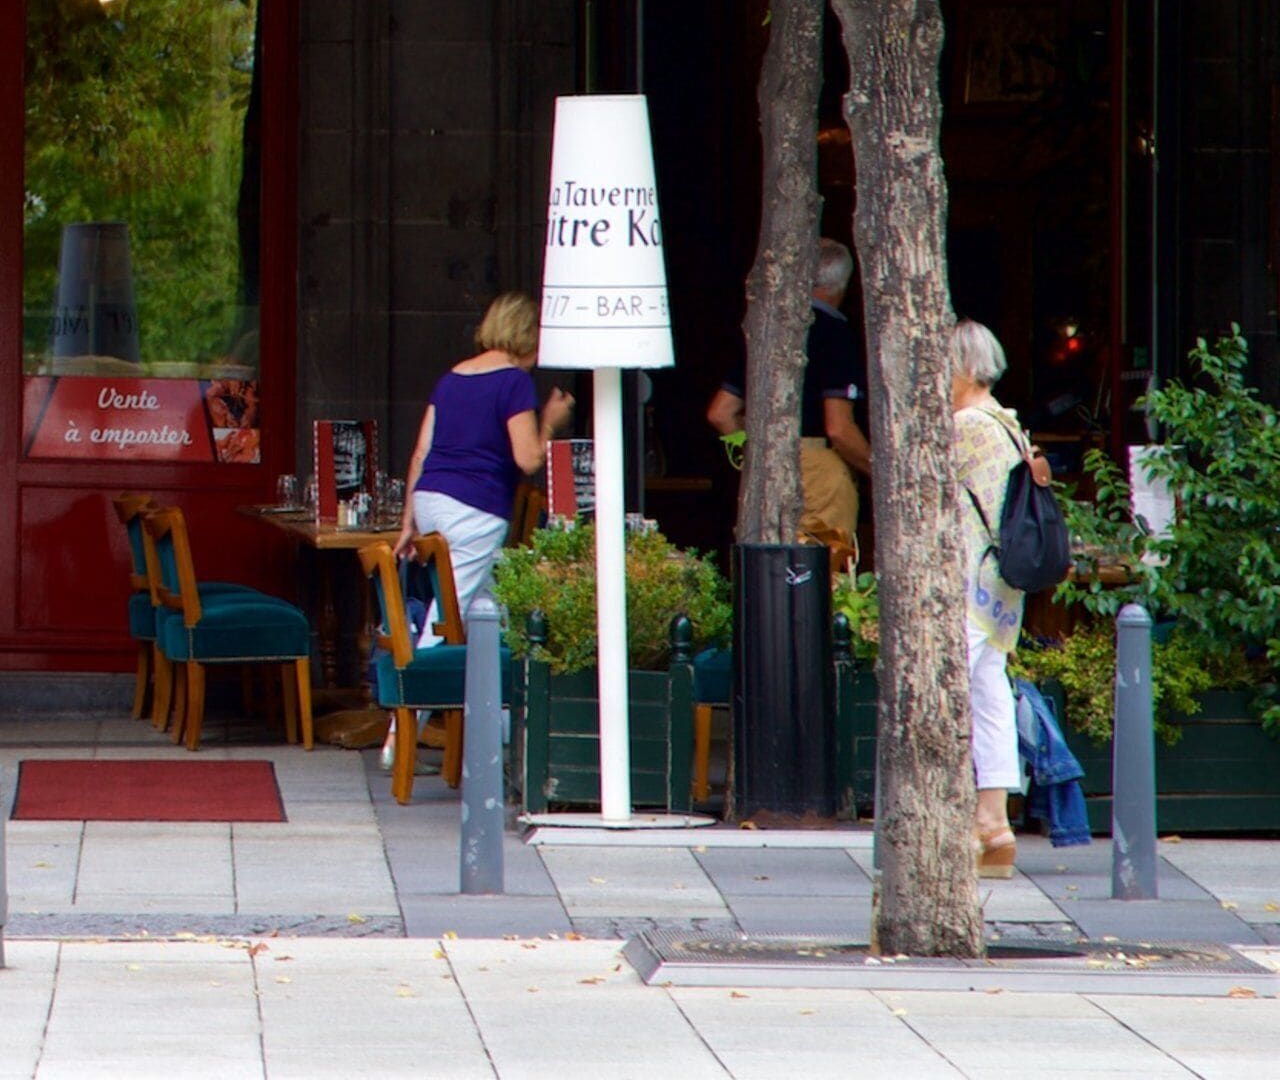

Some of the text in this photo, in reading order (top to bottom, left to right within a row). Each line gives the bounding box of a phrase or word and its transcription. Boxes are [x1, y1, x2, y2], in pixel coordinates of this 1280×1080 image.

[565, 181, 655, 206] Taverne
[597, 296, 644, 317] BAR
[97, 387, 160, 411] Vente
[65, 420, 193, 448] à emporter
